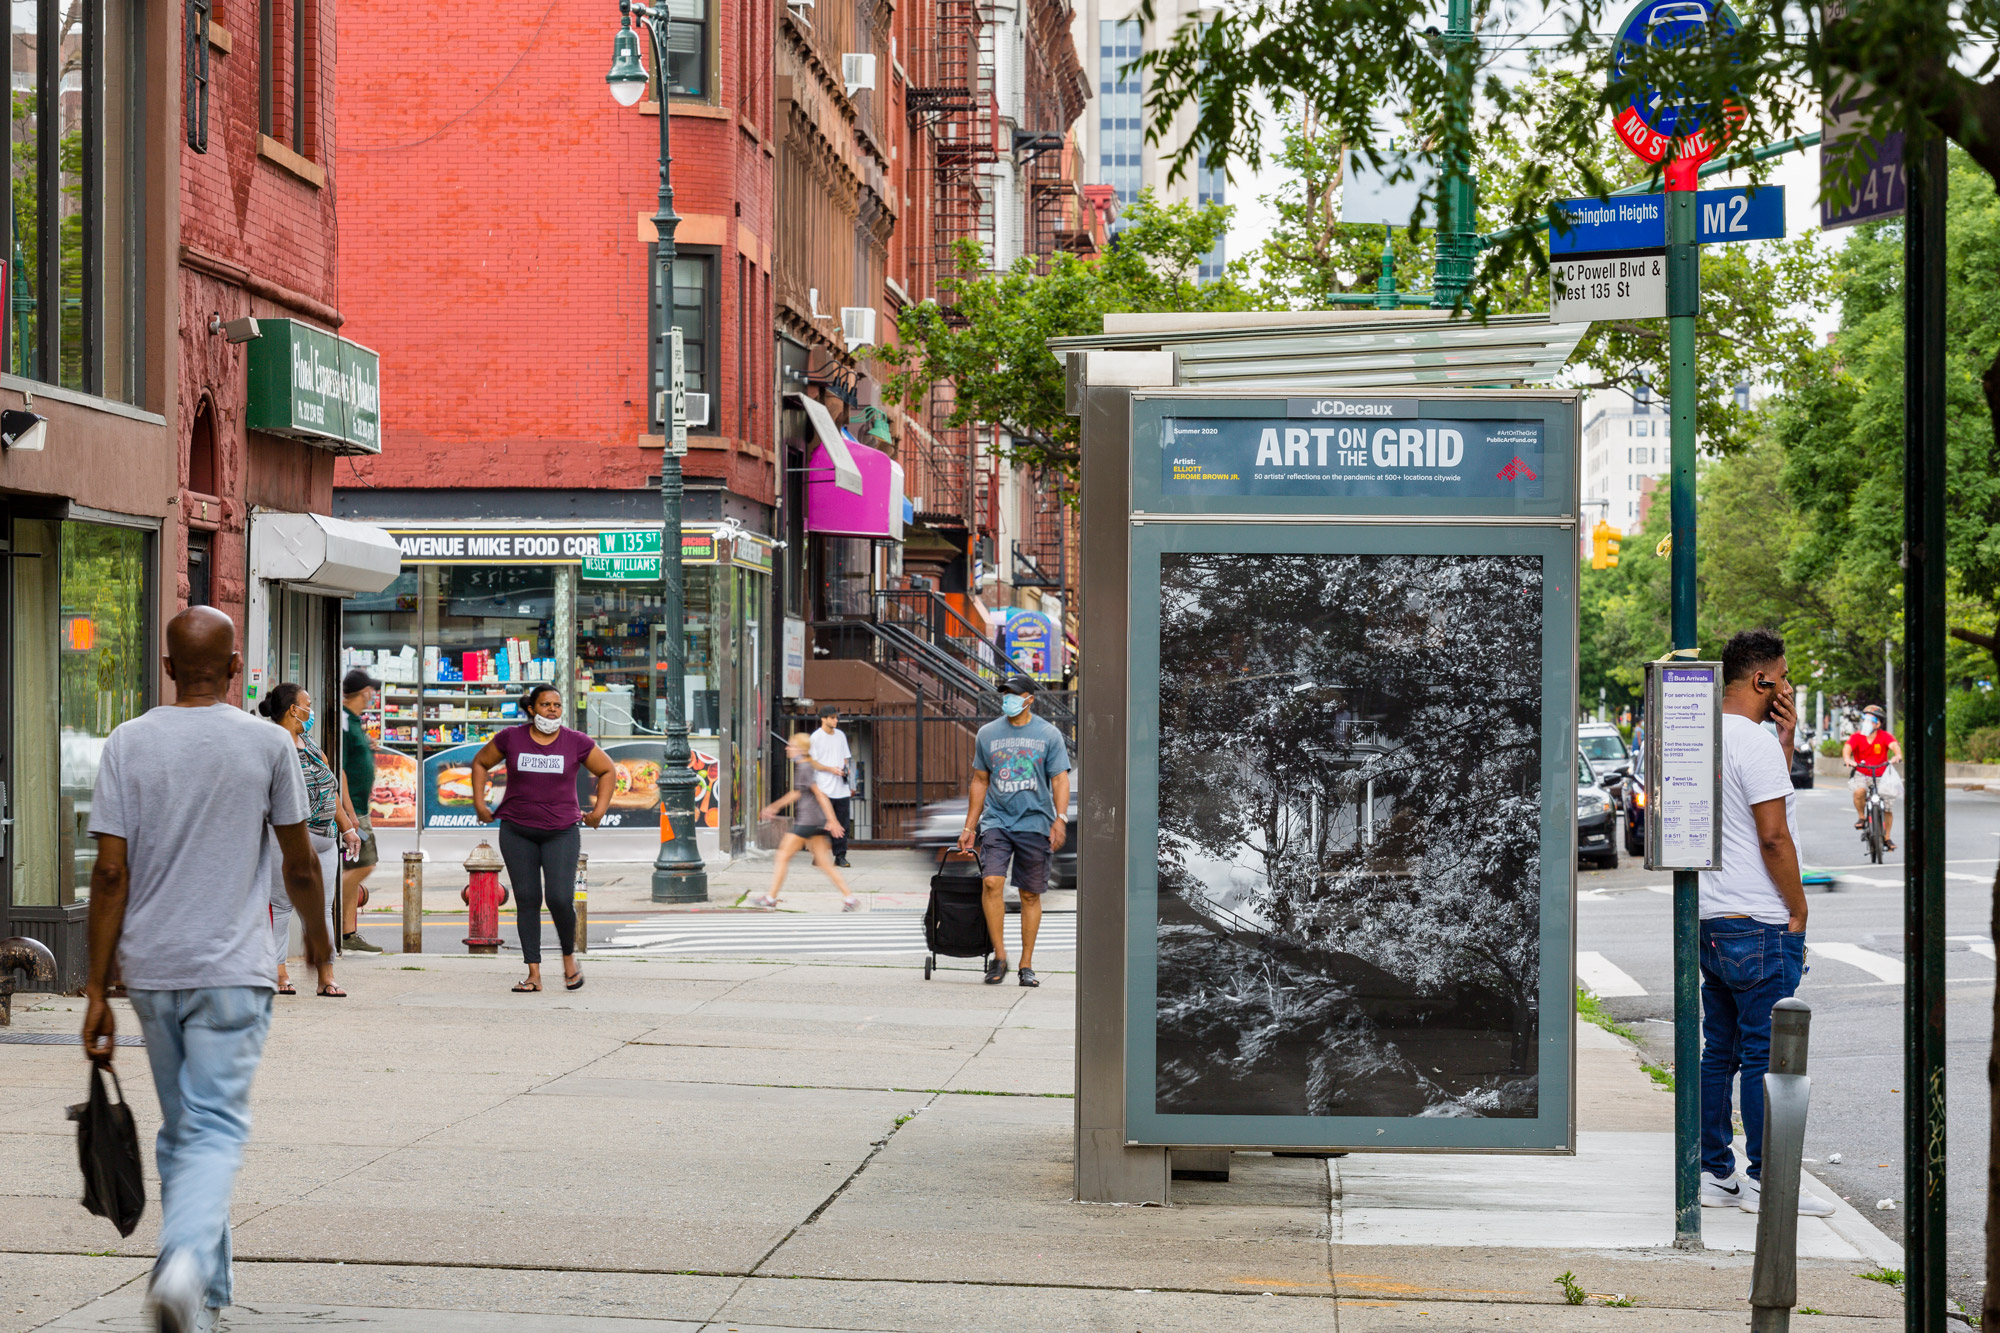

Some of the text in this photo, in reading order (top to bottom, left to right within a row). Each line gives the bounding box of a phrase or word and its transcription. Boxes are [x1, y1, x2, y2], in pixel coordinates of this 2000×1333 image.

[1623, 115, 1648, 145] NO
[1619, 203, 1659, 224] Heights
[1703, 195, 1749, 235] M2
[1556, 260, 1661, 281] A C Powell Blvd &
[1591, 283, 1610, 299] 135
[1617, 281, 1630, 298] St
[674, 380, 684, 415] 25
[1312, 401, 1393, 416] JCDecaux
[1173, 427, 1200, 435] Summer
[1255, 428, 1464, 468] ART ON THE GRID
[1496, 456, 1521, 480] PUBLIC
[1507, 467, 1522, 482] ART
[1519, 461, 1537, 481] FUND
[1344, 474, 1376, 482] pandemic
[400, 537, 600, 557] AVENUE MIKE FOOD COR
[605, 533, 657, 551] W 135 ST
[681, 546, 711, 556] OTHIES
[585, 558, 656, 571] WESLEY WILLIAMS
[605, 571, 625, 579] PLACE
[991, 737, 1046, 753] NEIGHBORHOOD
[521, 756, 561, 769] PINK
[996, 777, 1038, 793] WATCH
[428, 815, 487, 827] BREAKFA
